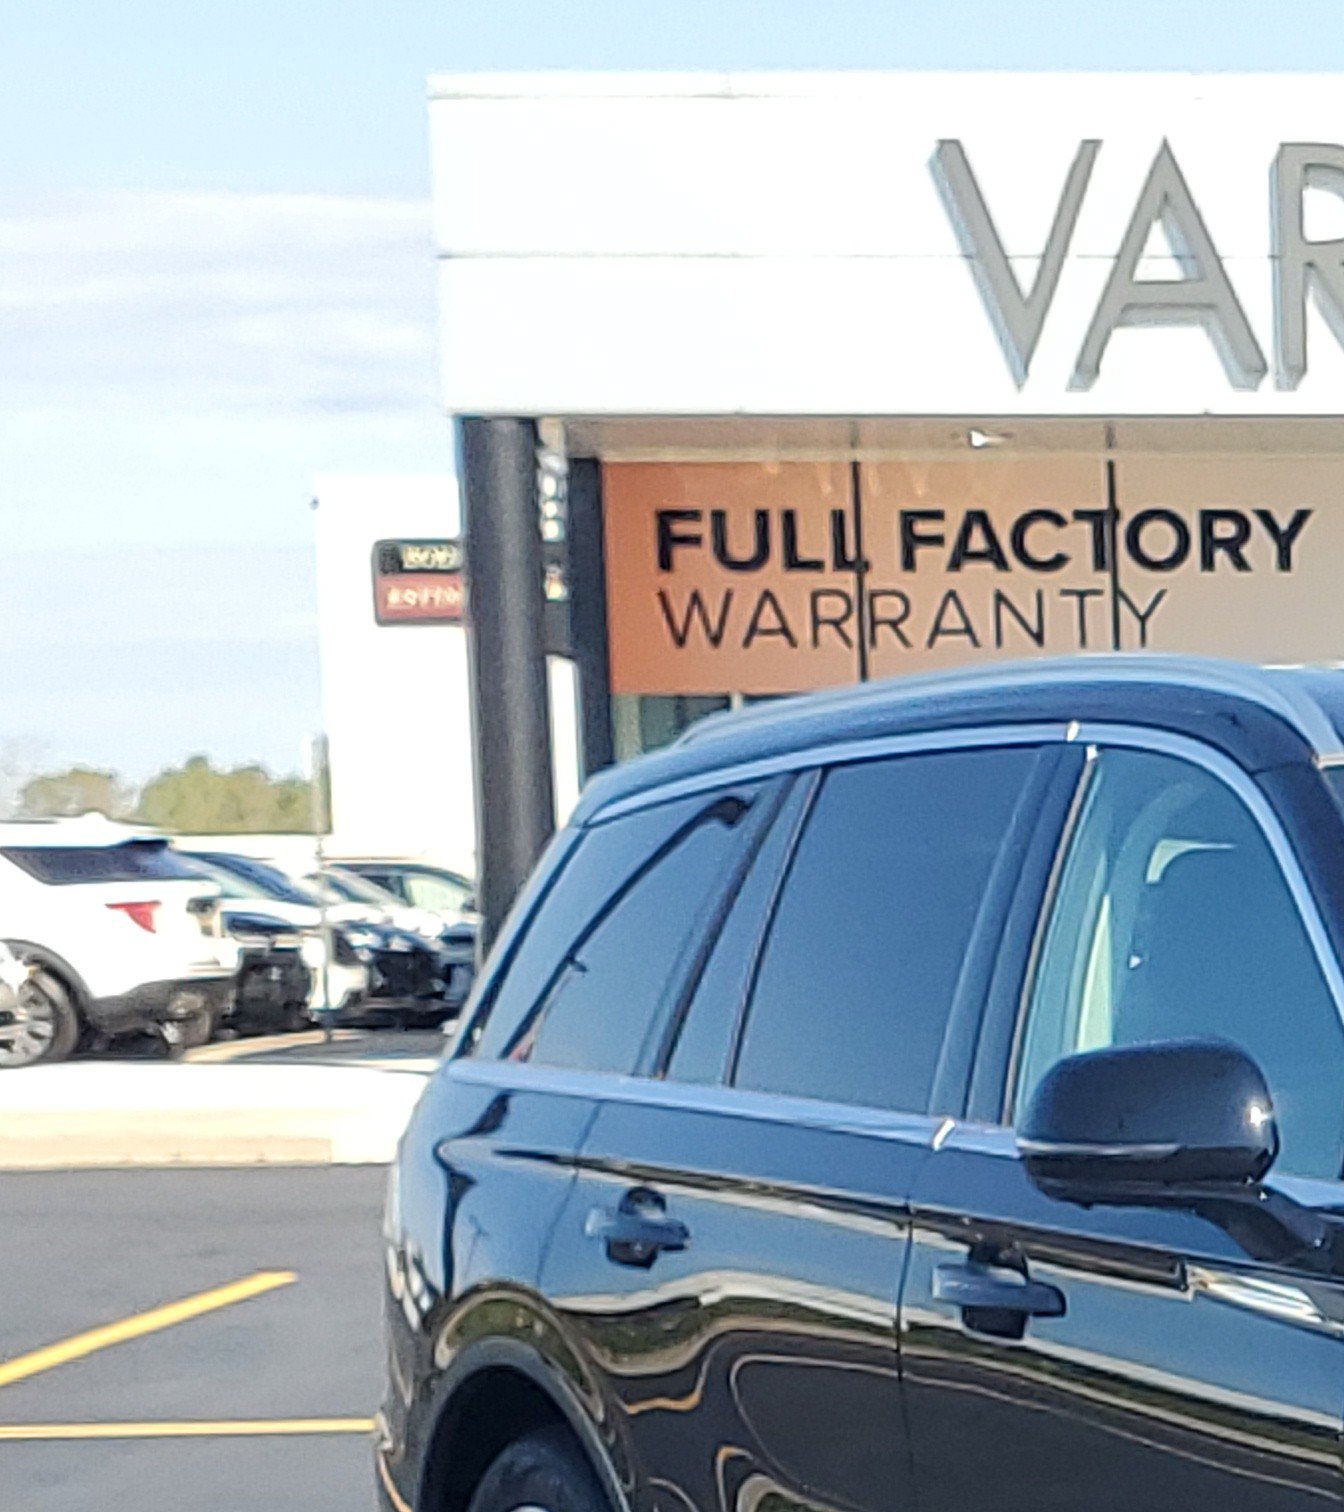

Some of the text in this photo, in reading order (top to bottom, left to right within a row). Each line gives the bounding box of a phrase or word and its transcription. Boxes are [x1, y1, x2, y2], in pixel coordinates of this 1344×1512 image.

[653, 508, 1313, 573] FULL FACTORY
[656, 588, 1168, 650] WARRANTY
